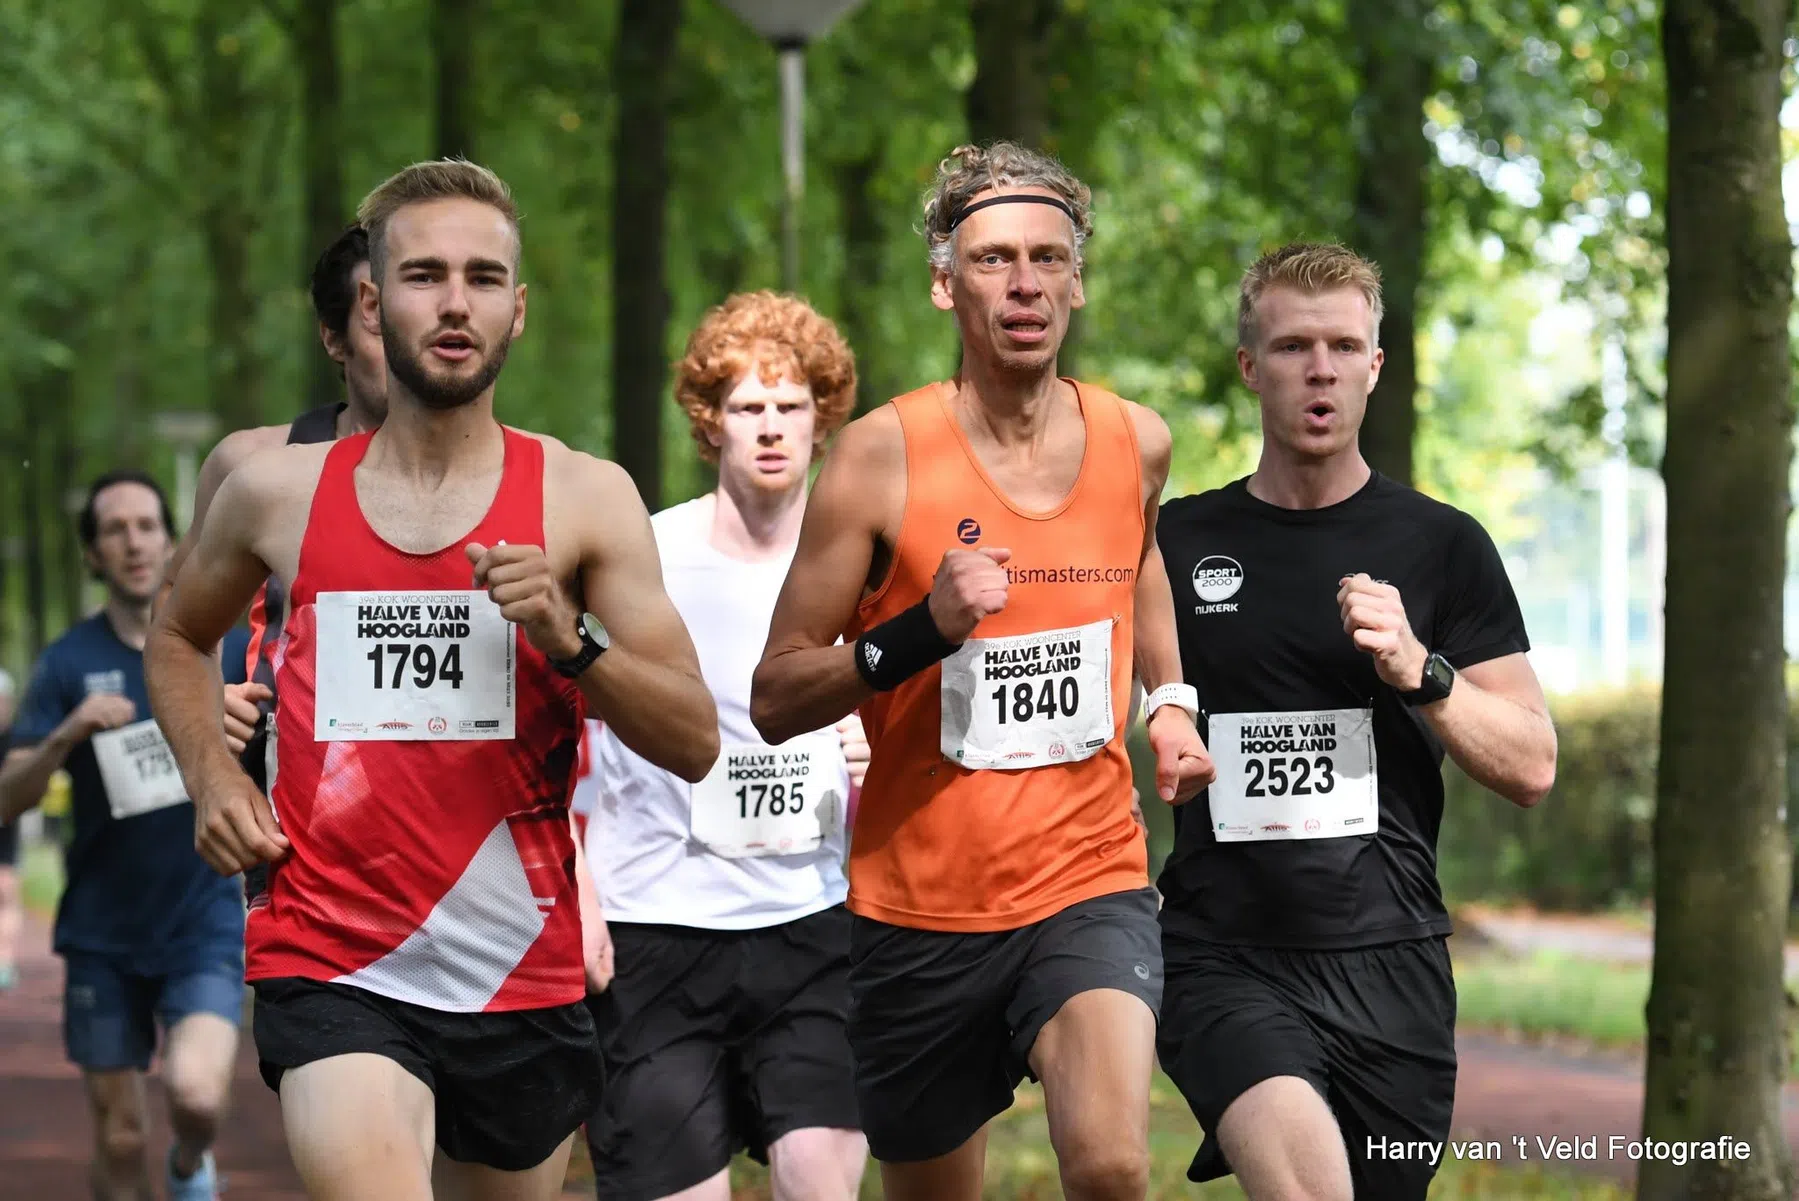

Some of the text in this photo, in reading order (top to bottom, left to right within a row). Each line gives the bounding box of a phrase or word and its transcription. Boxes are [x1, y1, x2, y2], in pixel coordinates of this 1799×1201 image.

[1001, 565, 1134, 584] tismasters.com
[1198, 568, 1237, 579] SPORT
[1202, 578, 1233, 588] 2000
[378, 595, 399, 604] KOK
[401, 595, 470, 604] WOONCENTER
[358, 605, 470, 621] HALVE VAN
[358, 623, 470, 639] HOOGLAND
[1003, 639, 1022, 649] KOK
[1024, 631, 1081, 646] WOONCENTER
[985, 639, 1081, 665] HALVE VAN
[367, 644, 463, 689] 1794
[985, 656, 1081, 680] HOOGLAND
[992, 676, 1079, 725] 1840
[1256, 716, 1273, 725] KOK
[1276, 714, 1336, 723] WOONCENTER
[1241, 723, 1336, 739] HALVE VAN
[1241, 738, 1337, 754] HOOGLAND
[728, 755, 776, 767] HALVE
[728, 766, 810, 780] HOOGLAND
[1245, 756, 1335, 798] 2523
[735, 782, 804, 818] 1785
